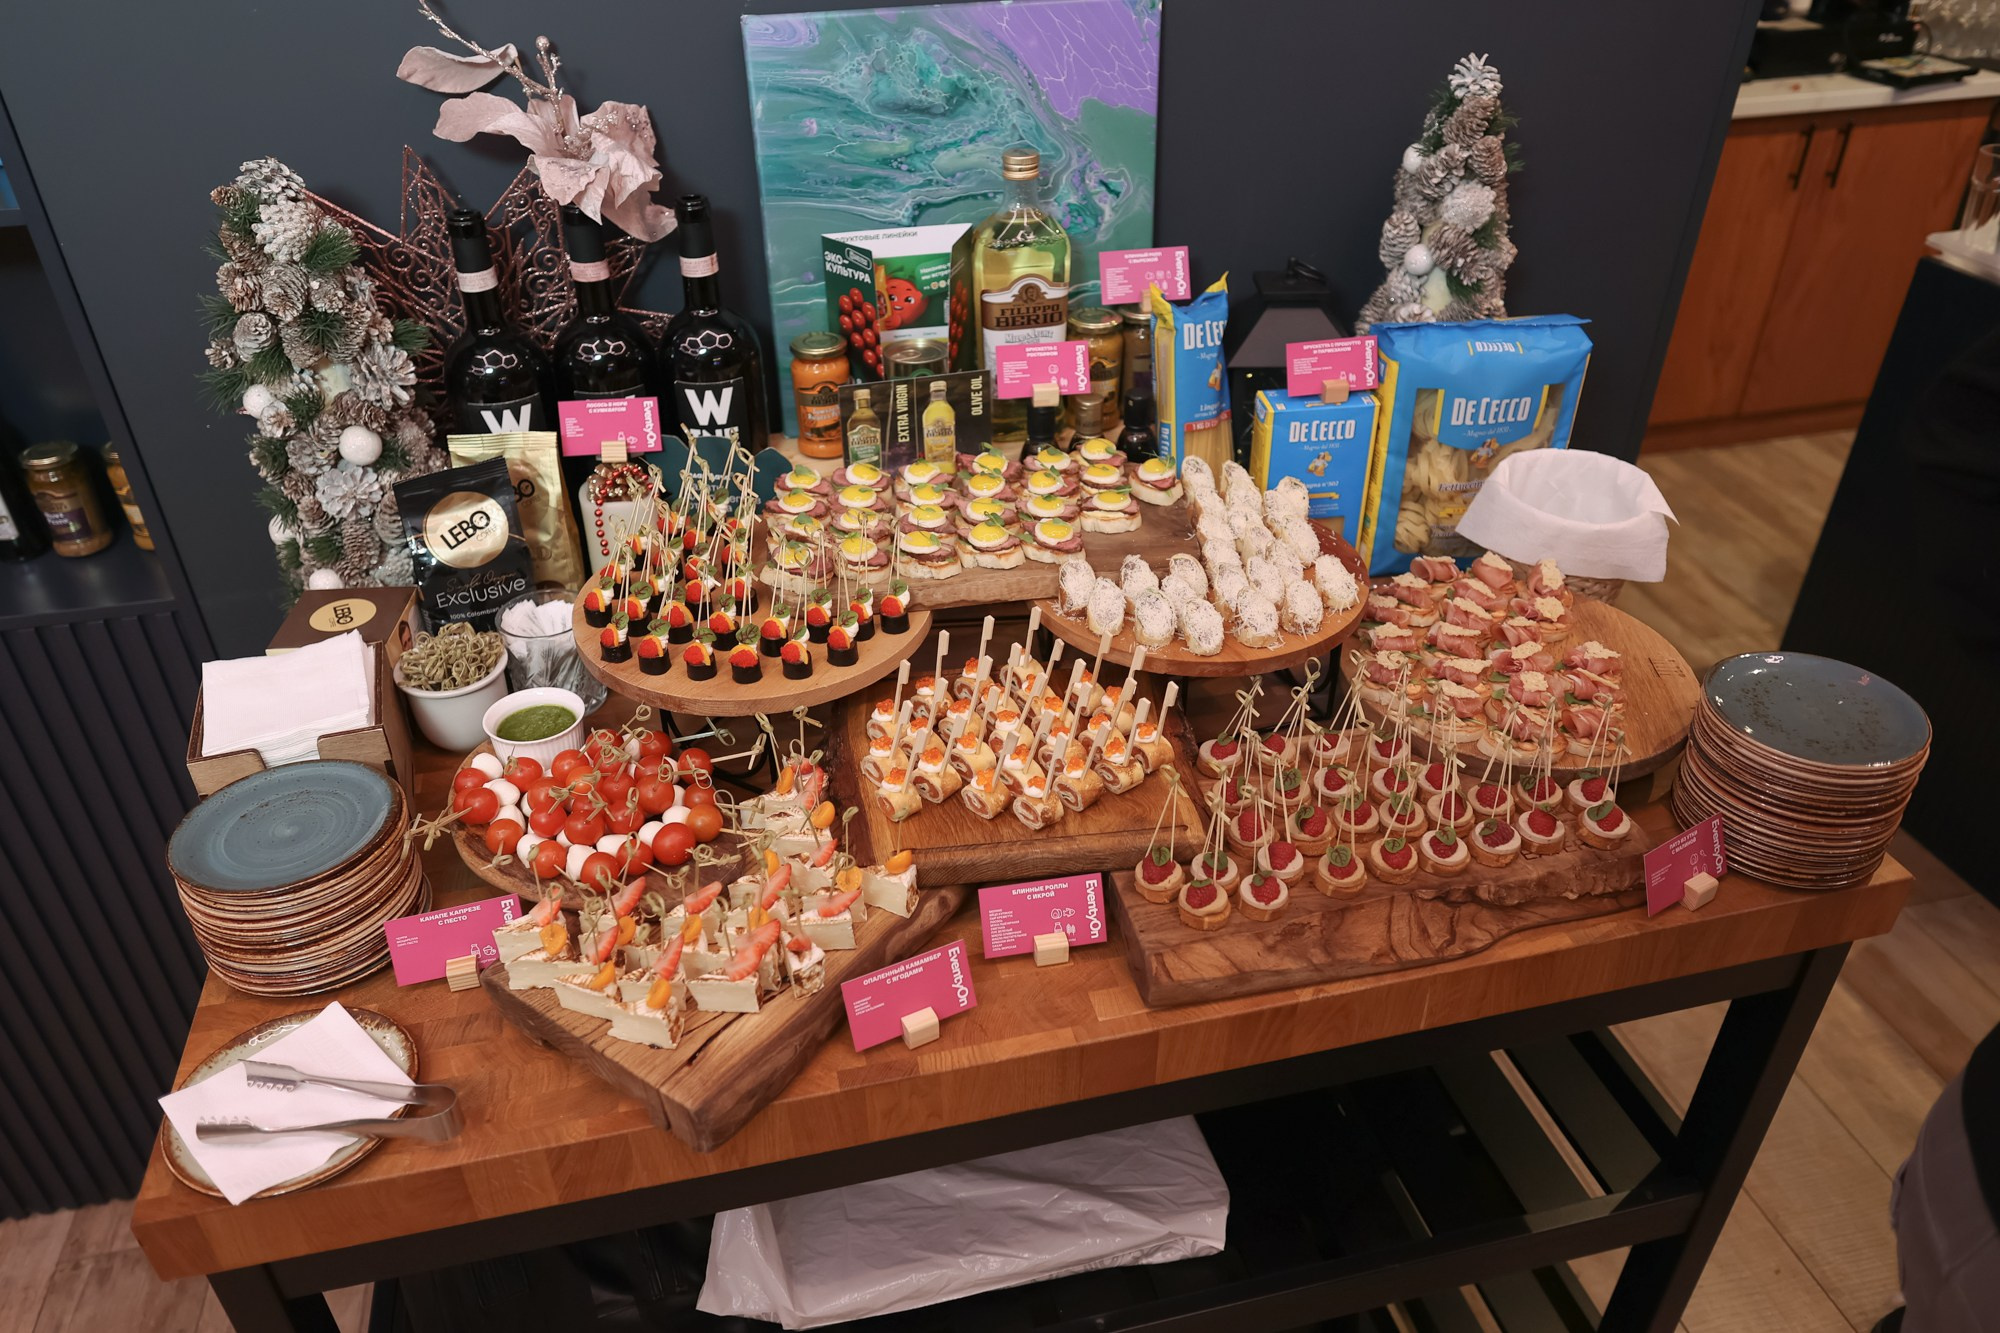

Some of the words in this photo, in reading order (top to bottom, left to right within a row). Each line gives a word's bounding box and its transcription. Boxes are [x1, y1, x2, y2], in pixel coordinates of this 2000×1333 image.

[824, 251, 849, 265] ЭКО-
[825, 261, 872, 284] КУЛЬТУРА
[1174, 250, 1187, 296] EventyOn
[994, 311, 1063, 328] BERIO
[1000, 304, 1060, 316] FILIPPO
[1183, 323, 1205, 350] DE
[1075, 345, 1088, 391] EventyOn
[1363, 340, 1375, 386] EventyOn
[971, 375, 983, 391] OIL
[684, 386, 734, 426] W
[896, 384, 909, 412] VIRGIN
[971, 393, 983, 416] OLIVE
[1451, 397, 1477, 426] DE
[1478, 396, 1532, 425] CECCO
[480, 403, 532, 434] W
[643, 400, 657, 448] EventyOn
[898, 414, 910, 443] EXTRA
[1289, 421, 1309, 443] DE
[1311, 420, 1356, 442] CECCO
[1438, 479, 1485, 492] Fettuccin
[440, 510, 491, 550] LEBO
[436, 578, 526, 608] Exclusive
[333, 603, 354, 625] LEBO
[450, 611, 466, 620] 100%
[466, 607, 500, 618] Colombian
[1711, 819, 1724, 874] EventyOn
[1012, 886, 1044, 895] БЛИННЫЕ
[1045, 883, 1068, 891] РОЛЛЫ
[1033, 890, 1055, 899] ИКРОЙ
[420, 913, 448, 923] КАНАПЕ
[449, 905, 481, 916] КАПРЕЗЕ
[444, 915, 468, 925] ПЕСТО
[1086, 879, 1102, 939] EventyOn
[863, 965, 905, 986] ОПАЛЕННЫЙ
[906, 952, 941, 969] КАМАМБЕР
[892, 966, 924, 983] ЯГОДАМИ
[948, 946, 969, 1007] EventyOn
